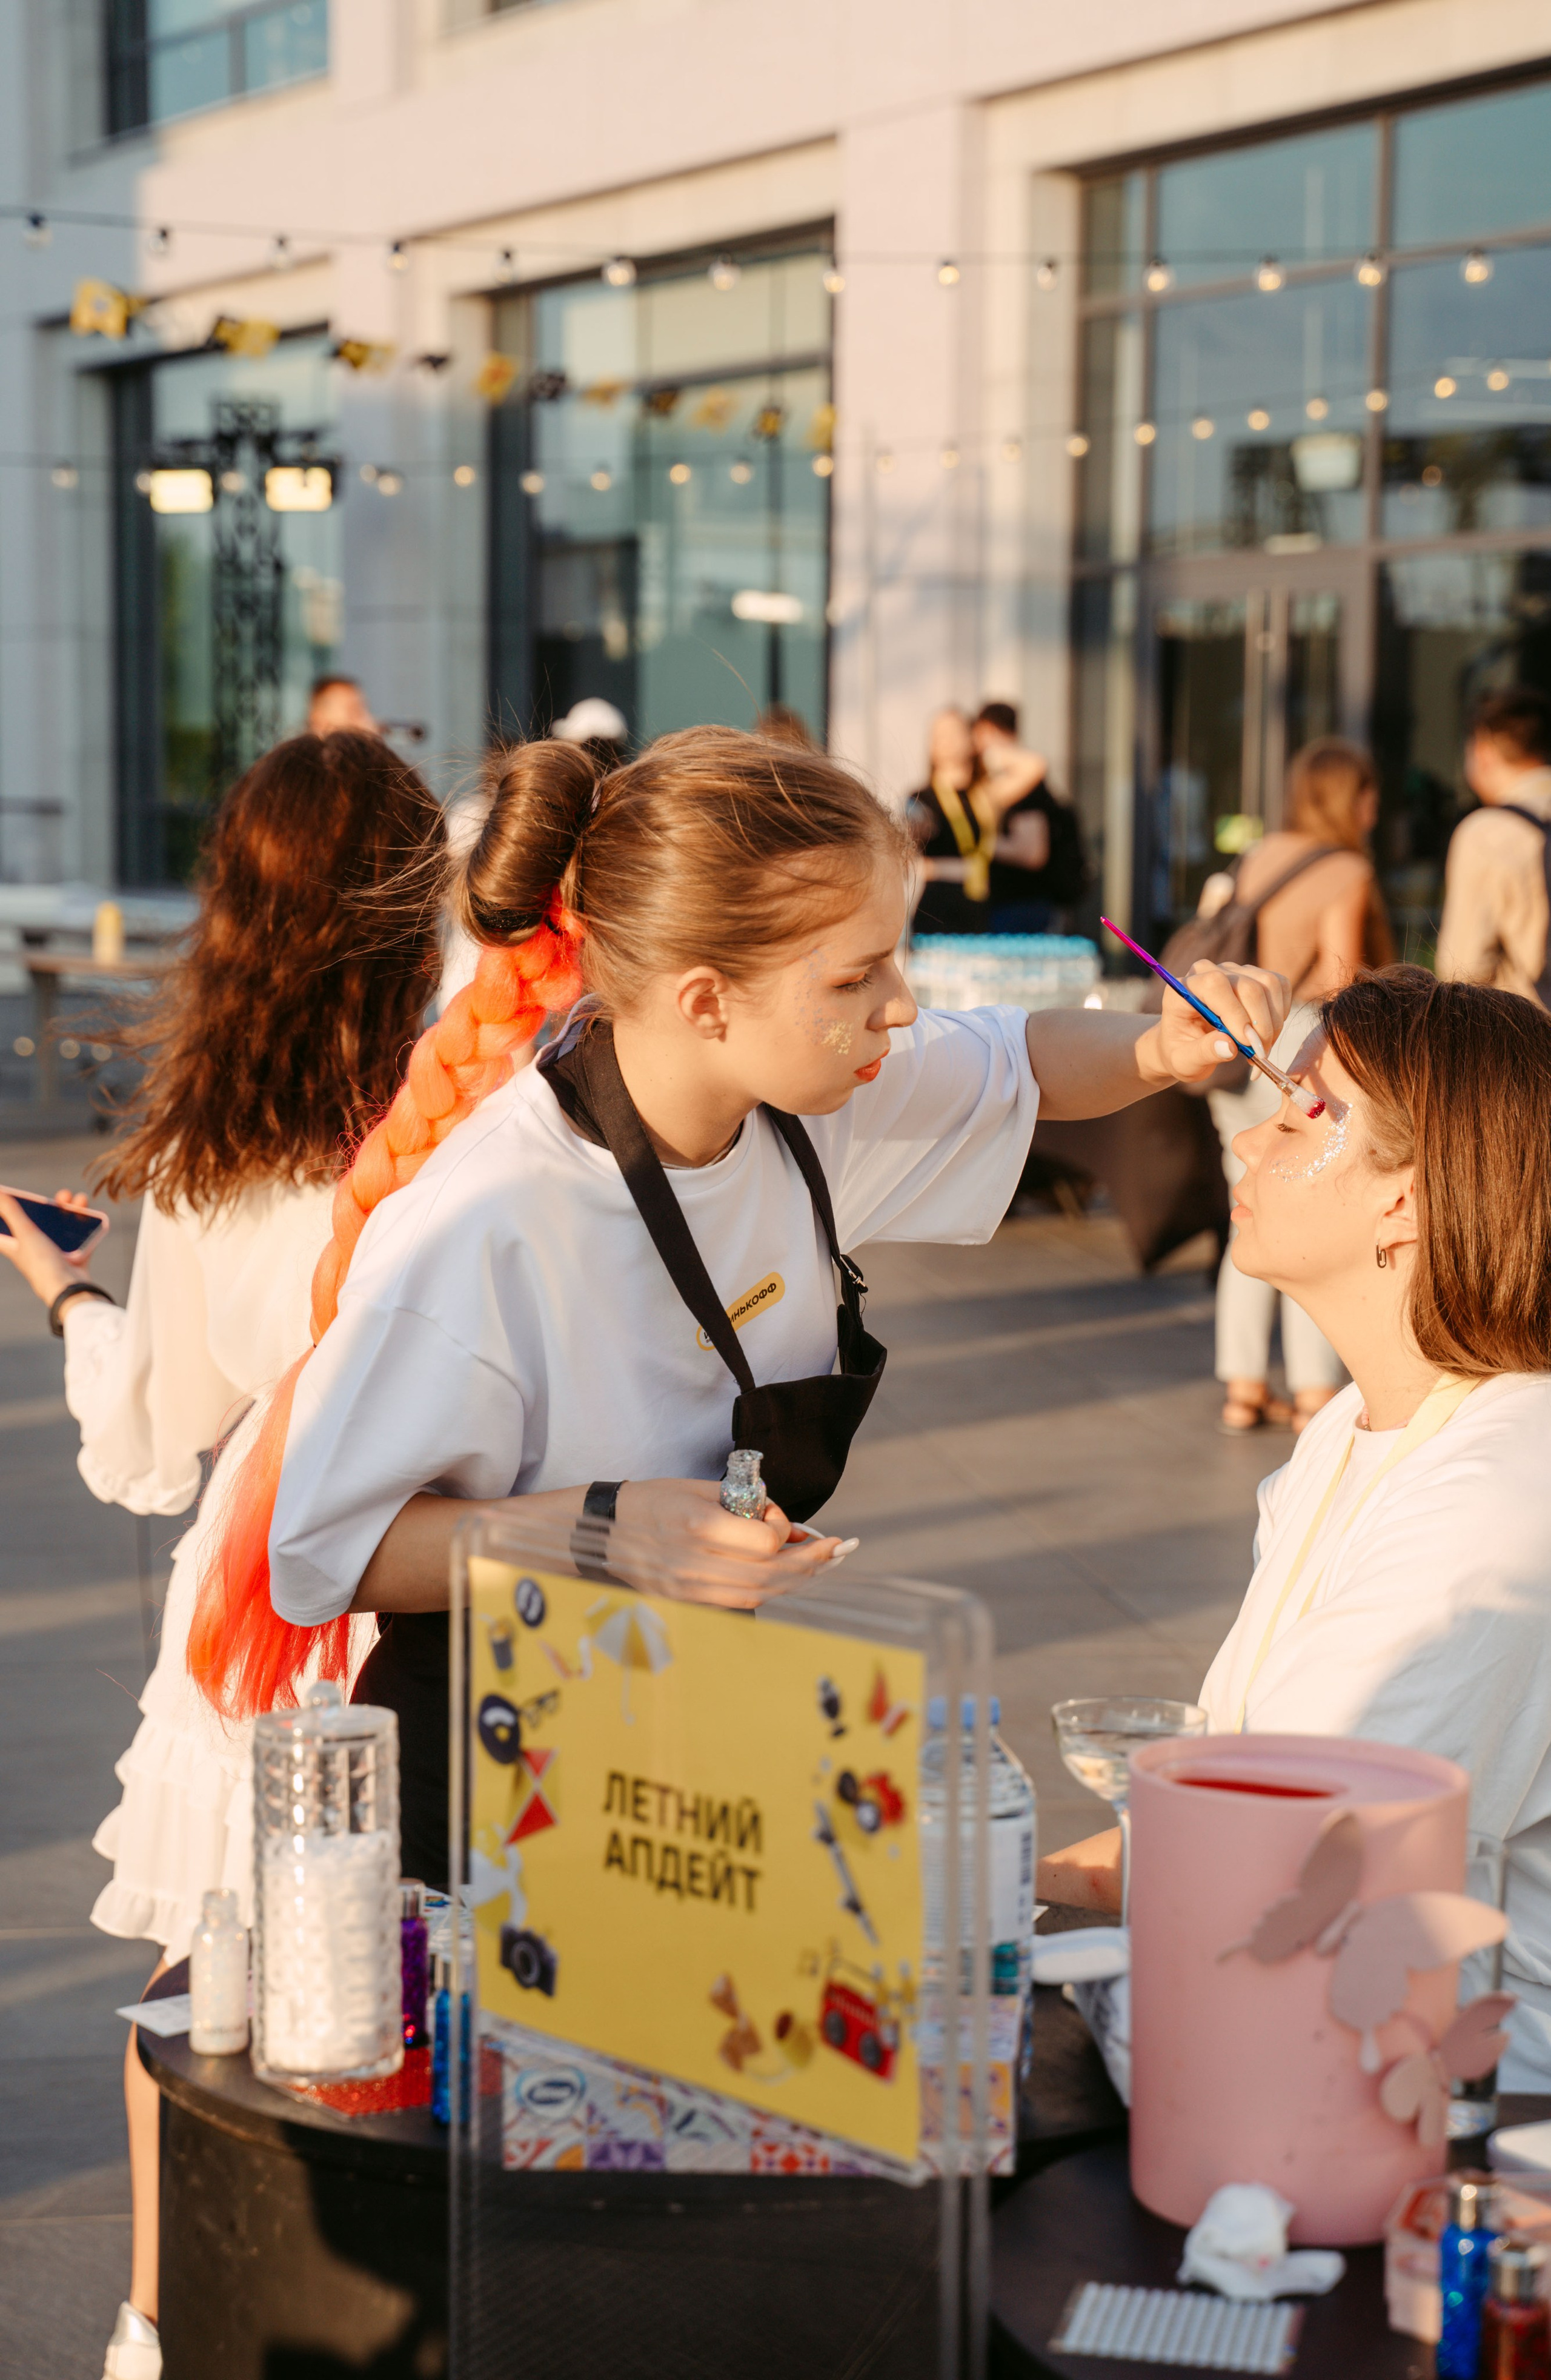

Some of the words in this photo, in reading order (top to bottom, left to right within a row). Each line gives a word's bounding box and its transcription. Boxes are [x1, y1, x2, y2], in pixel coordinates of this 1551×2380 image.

[728, 1282, 777, 1323] ИНЬКОФФ
[603, 1769, 762, 1854] ЛЕТНИЙ
[604, 1828, 762, 1912] АПДЕЙТ
